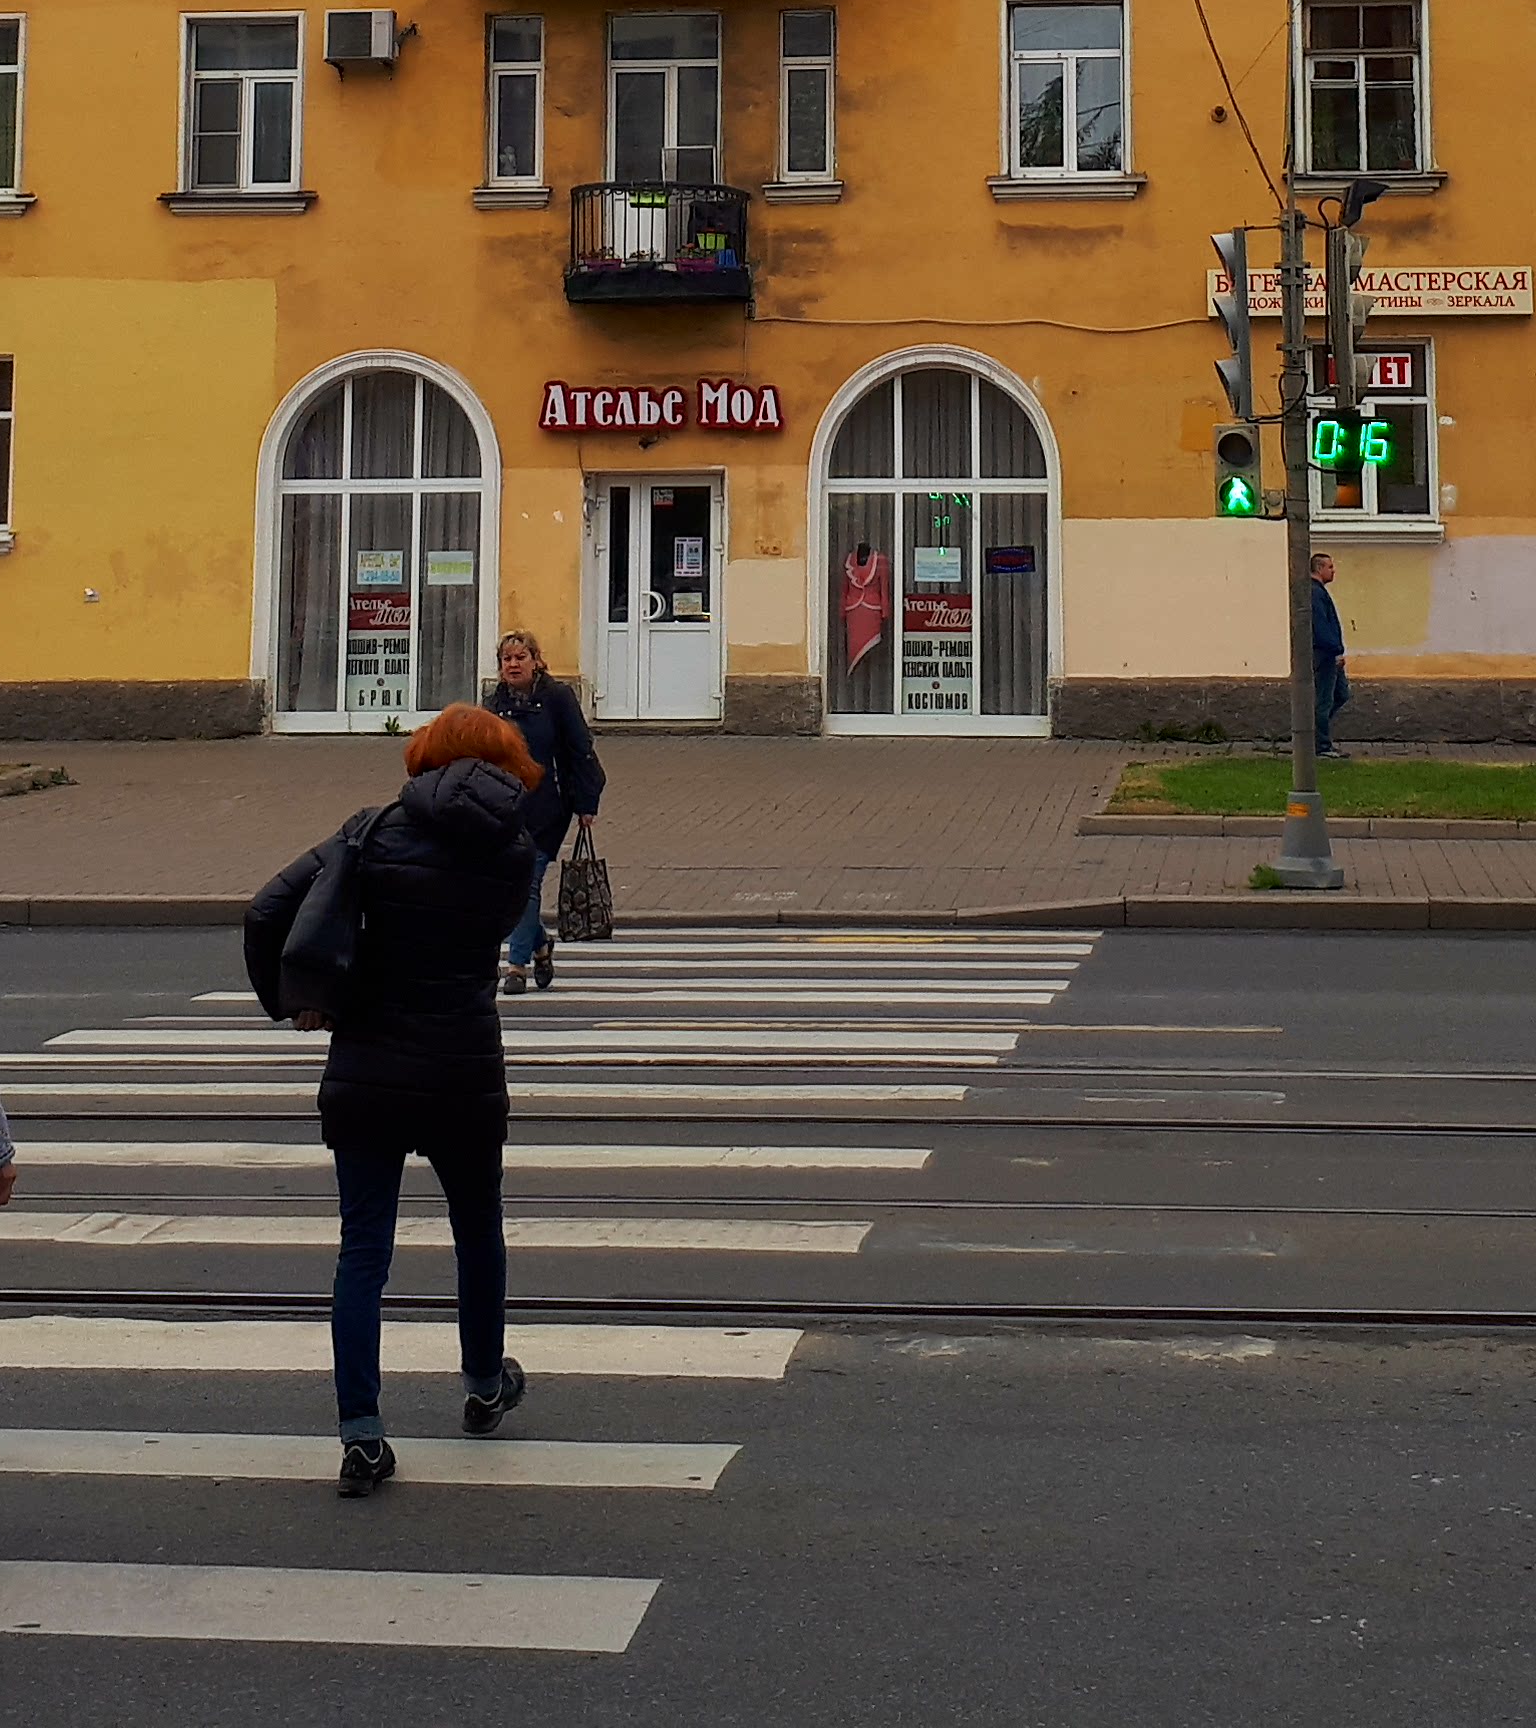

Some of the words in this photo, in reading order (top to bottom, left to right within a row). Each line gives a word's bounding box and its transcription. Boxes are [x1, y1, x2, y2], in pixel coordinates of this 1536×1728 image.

[1354, 270, 1528, 292] МАСТЕРСКАЯ
[1447, 294, 1515, 308] ЗЕРКАЛА
[543, 385, 683, 426] Ателье
[700, 382, 780, 427] Мод
[908, 692, 968, 710] КОСТЮМОВ
